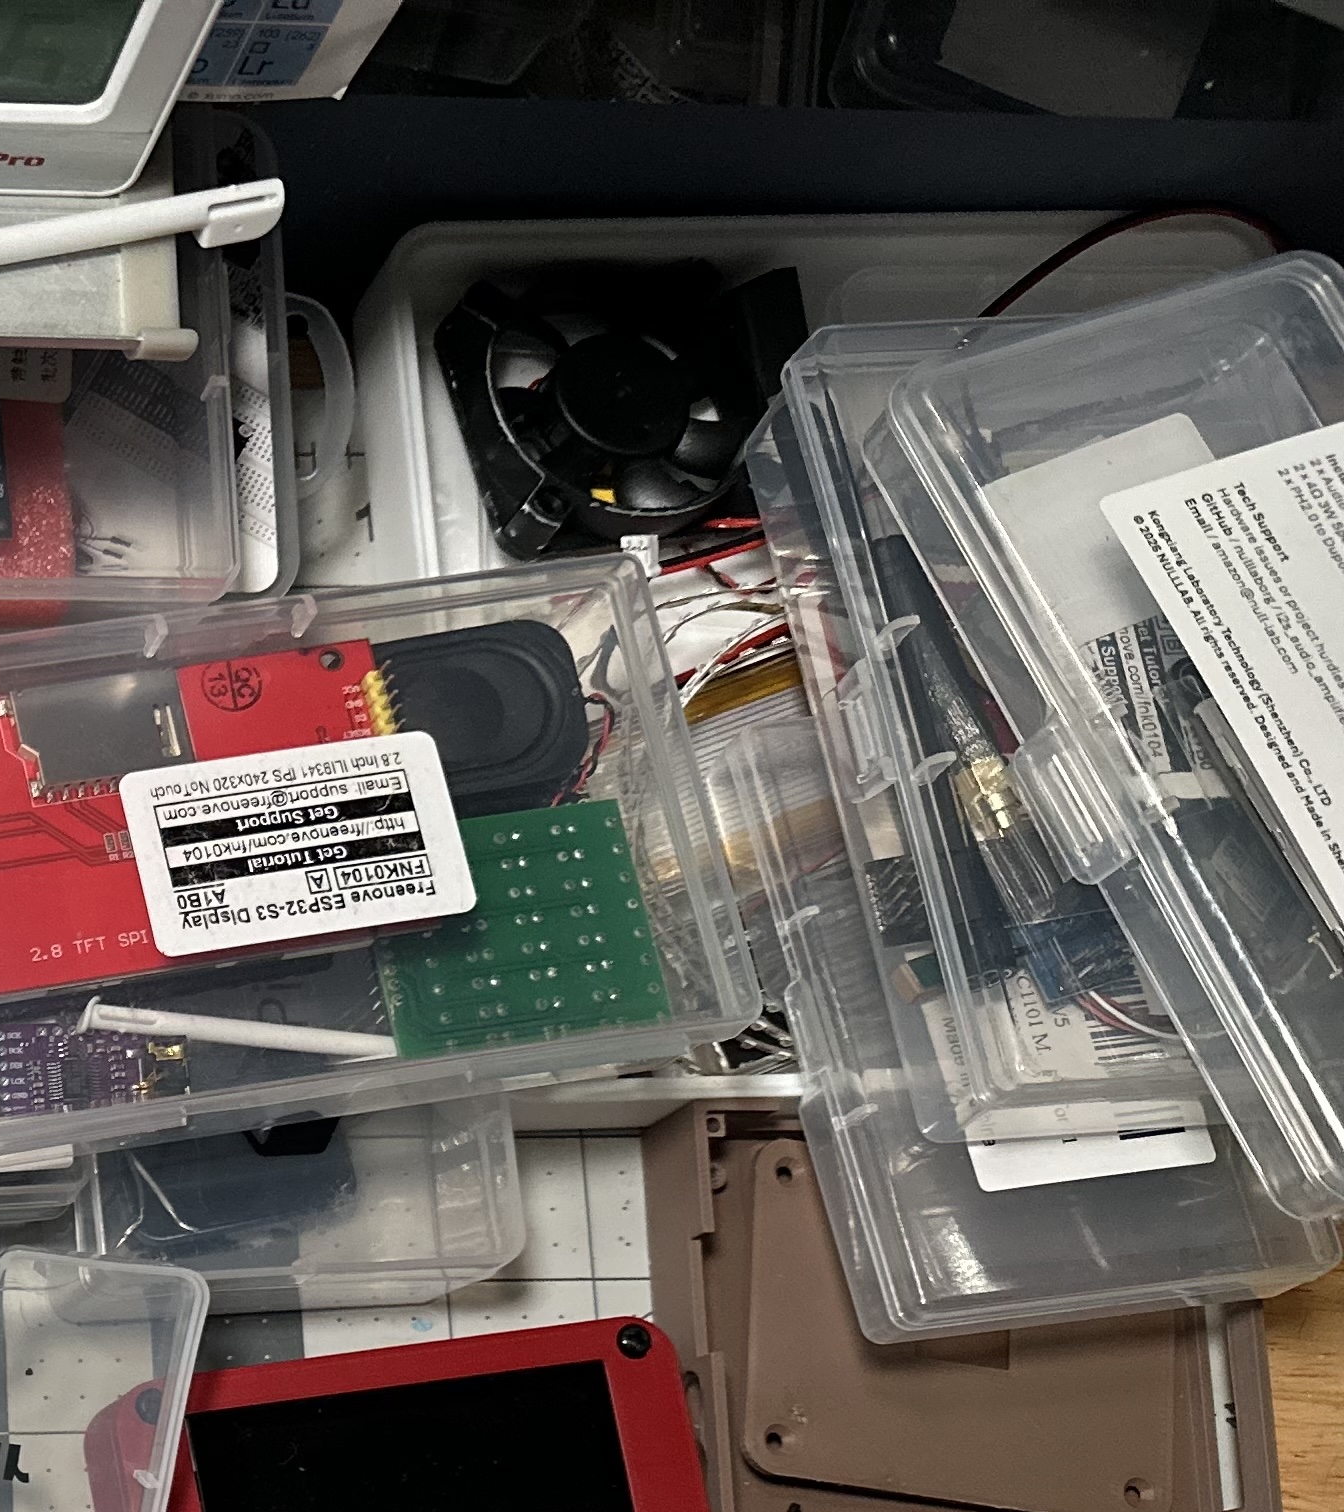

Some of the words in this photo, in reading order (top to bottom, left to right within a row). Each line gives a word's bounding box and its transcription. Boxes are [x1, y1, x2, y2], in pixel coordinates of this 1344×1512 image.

[238, 56, 274, 76] Lr
[1234, 481, 1256, 511] Tech
[1252, 507, 1290, 562] Support
[1220, 628, 1264, 694] Technology
[1313, 783, 1332, 807] LTD
[1254, 713, 1291, 770] Designed
[213, 771, 270, 791] 240x320
[274, 769, 296, 782] IPS
[150, 780, 210, 799] NoTouch
[163, 784, 349, 821] support@freenove.com
[312, 806, 341, 820] Get
[236, 812, 305, 831] Support
[248, 852, 313, 872] Tutorial
[320, 845, 348, 860] Get
[341, 860, 425, 884] FNK0104
[351, 880, 437, 903] Freenove
[181, 903, 251, 930] Display
[258, 895, 346, 922] ESP32-S3
[29, 944, 63, 962] 2.8
[72, 936, 106, 954] TFT
[118, 929, 149, 948] SPI
